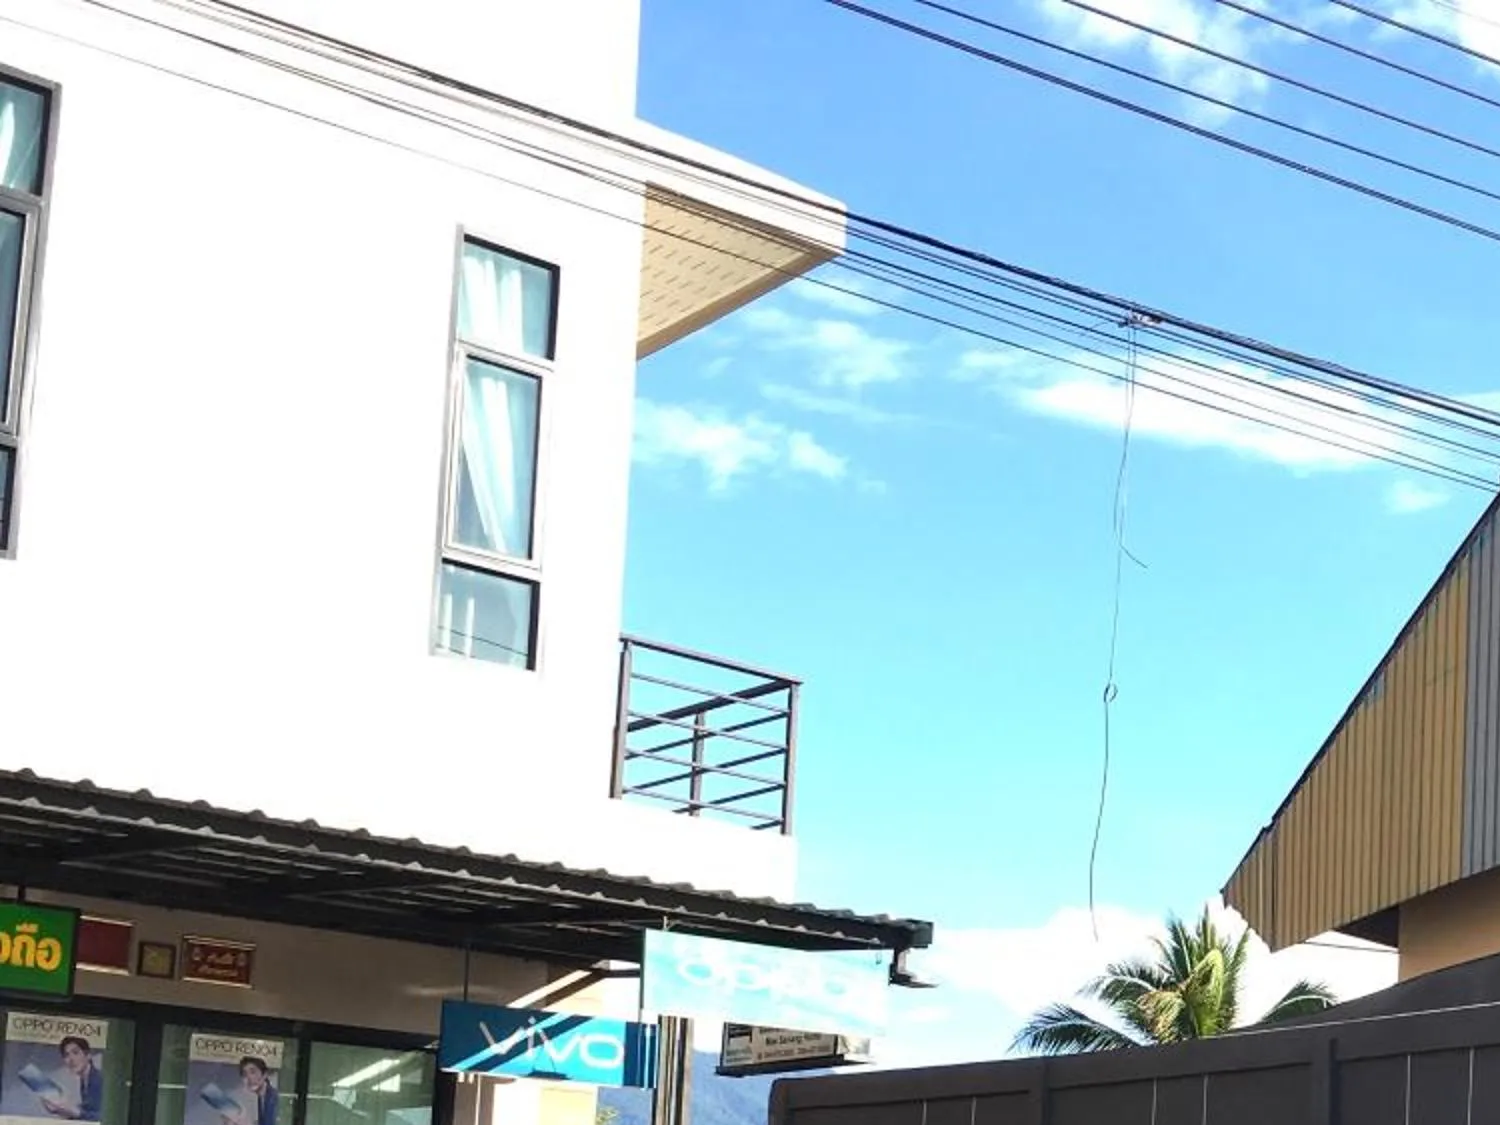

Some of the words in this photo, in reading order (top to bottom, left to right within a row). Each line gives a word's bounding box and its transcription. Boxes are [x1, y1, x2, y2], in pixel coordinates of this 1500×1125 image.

[12, 1016, 53, 1032] OPPO
[57, 1020, 101, 1037] RENO4
[195, 1038, 232, 1053] OPPO
[479, 1015, 626, 1069] vivo
